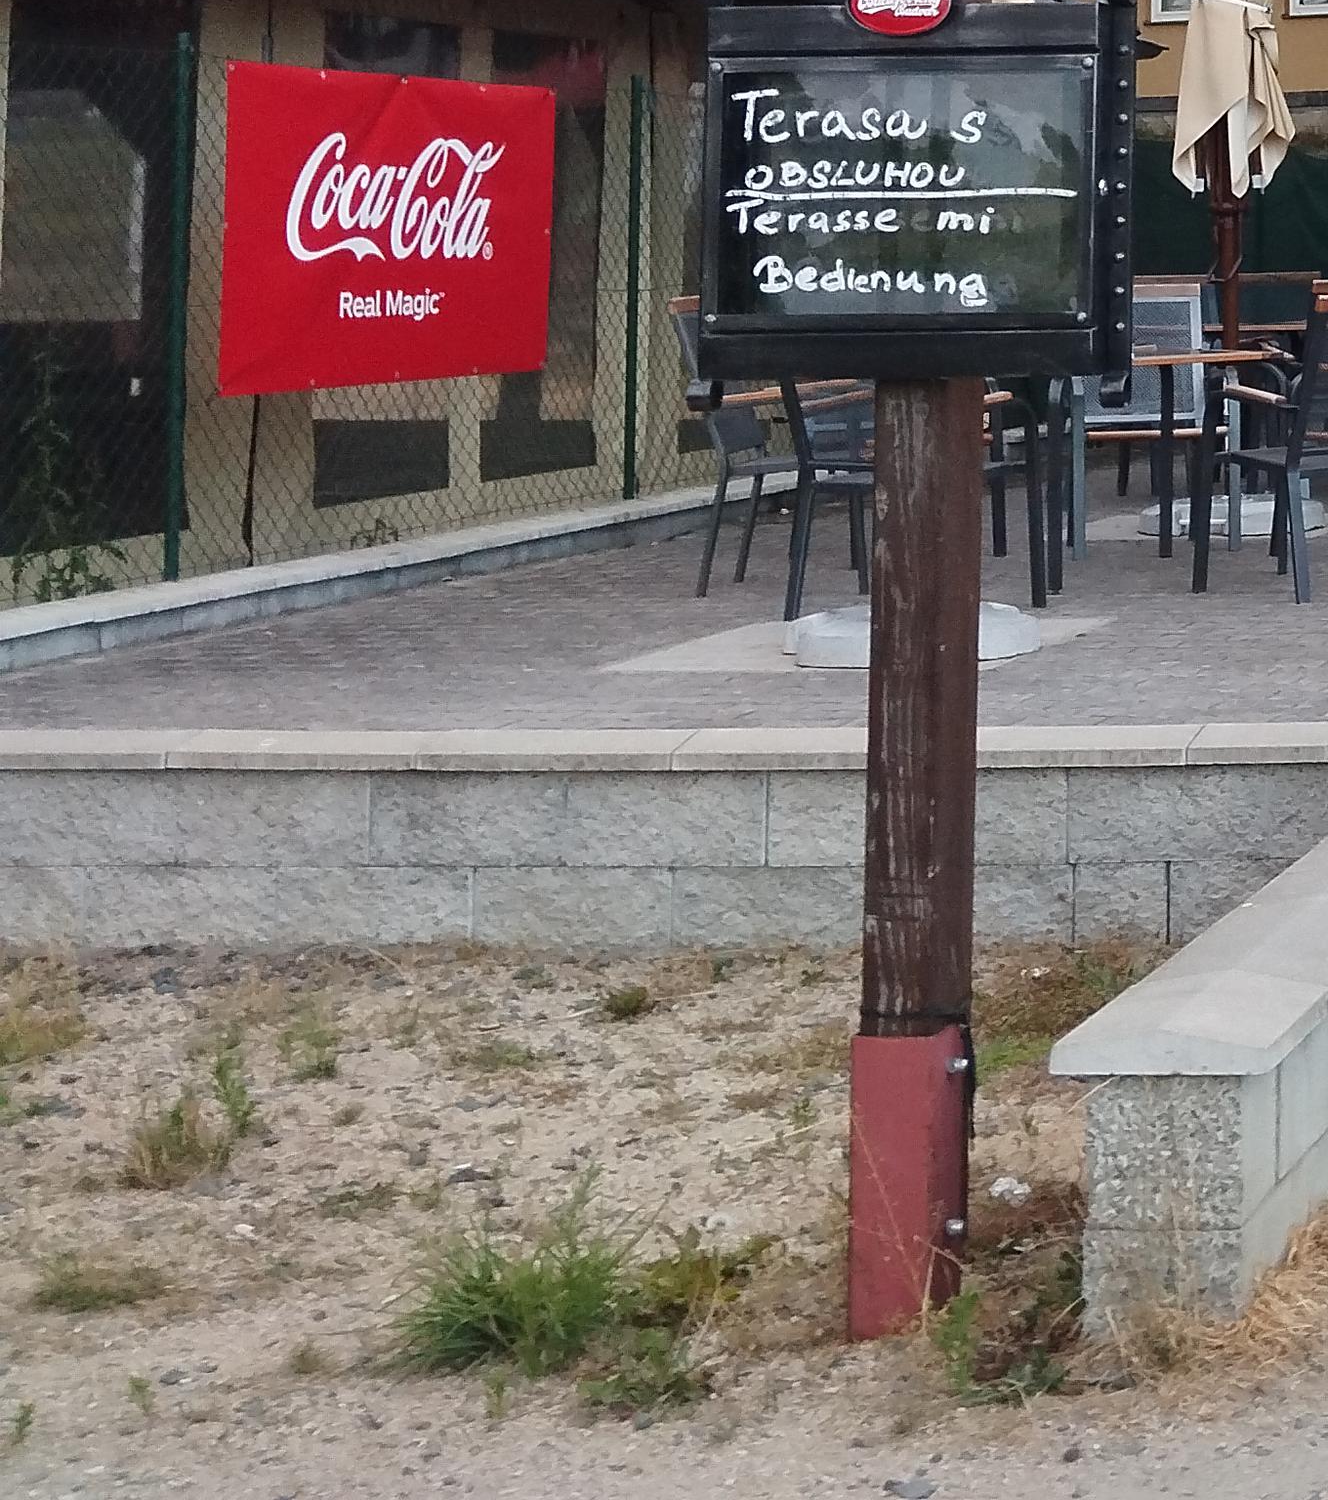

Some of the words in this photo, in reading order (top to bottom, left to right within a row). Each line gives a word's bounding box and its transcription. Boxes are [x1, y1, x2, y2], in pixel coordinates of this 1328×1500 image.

[731, 87, 928, 144] Terasa
[286, 132, 506, 262] Coca-Cola
[726, 199, 900, 235] Terasse
[339, 290, 382, 319] Real
[385, 287, 441, 321] Magic
[752, 254, 988, 307] Bedienung
